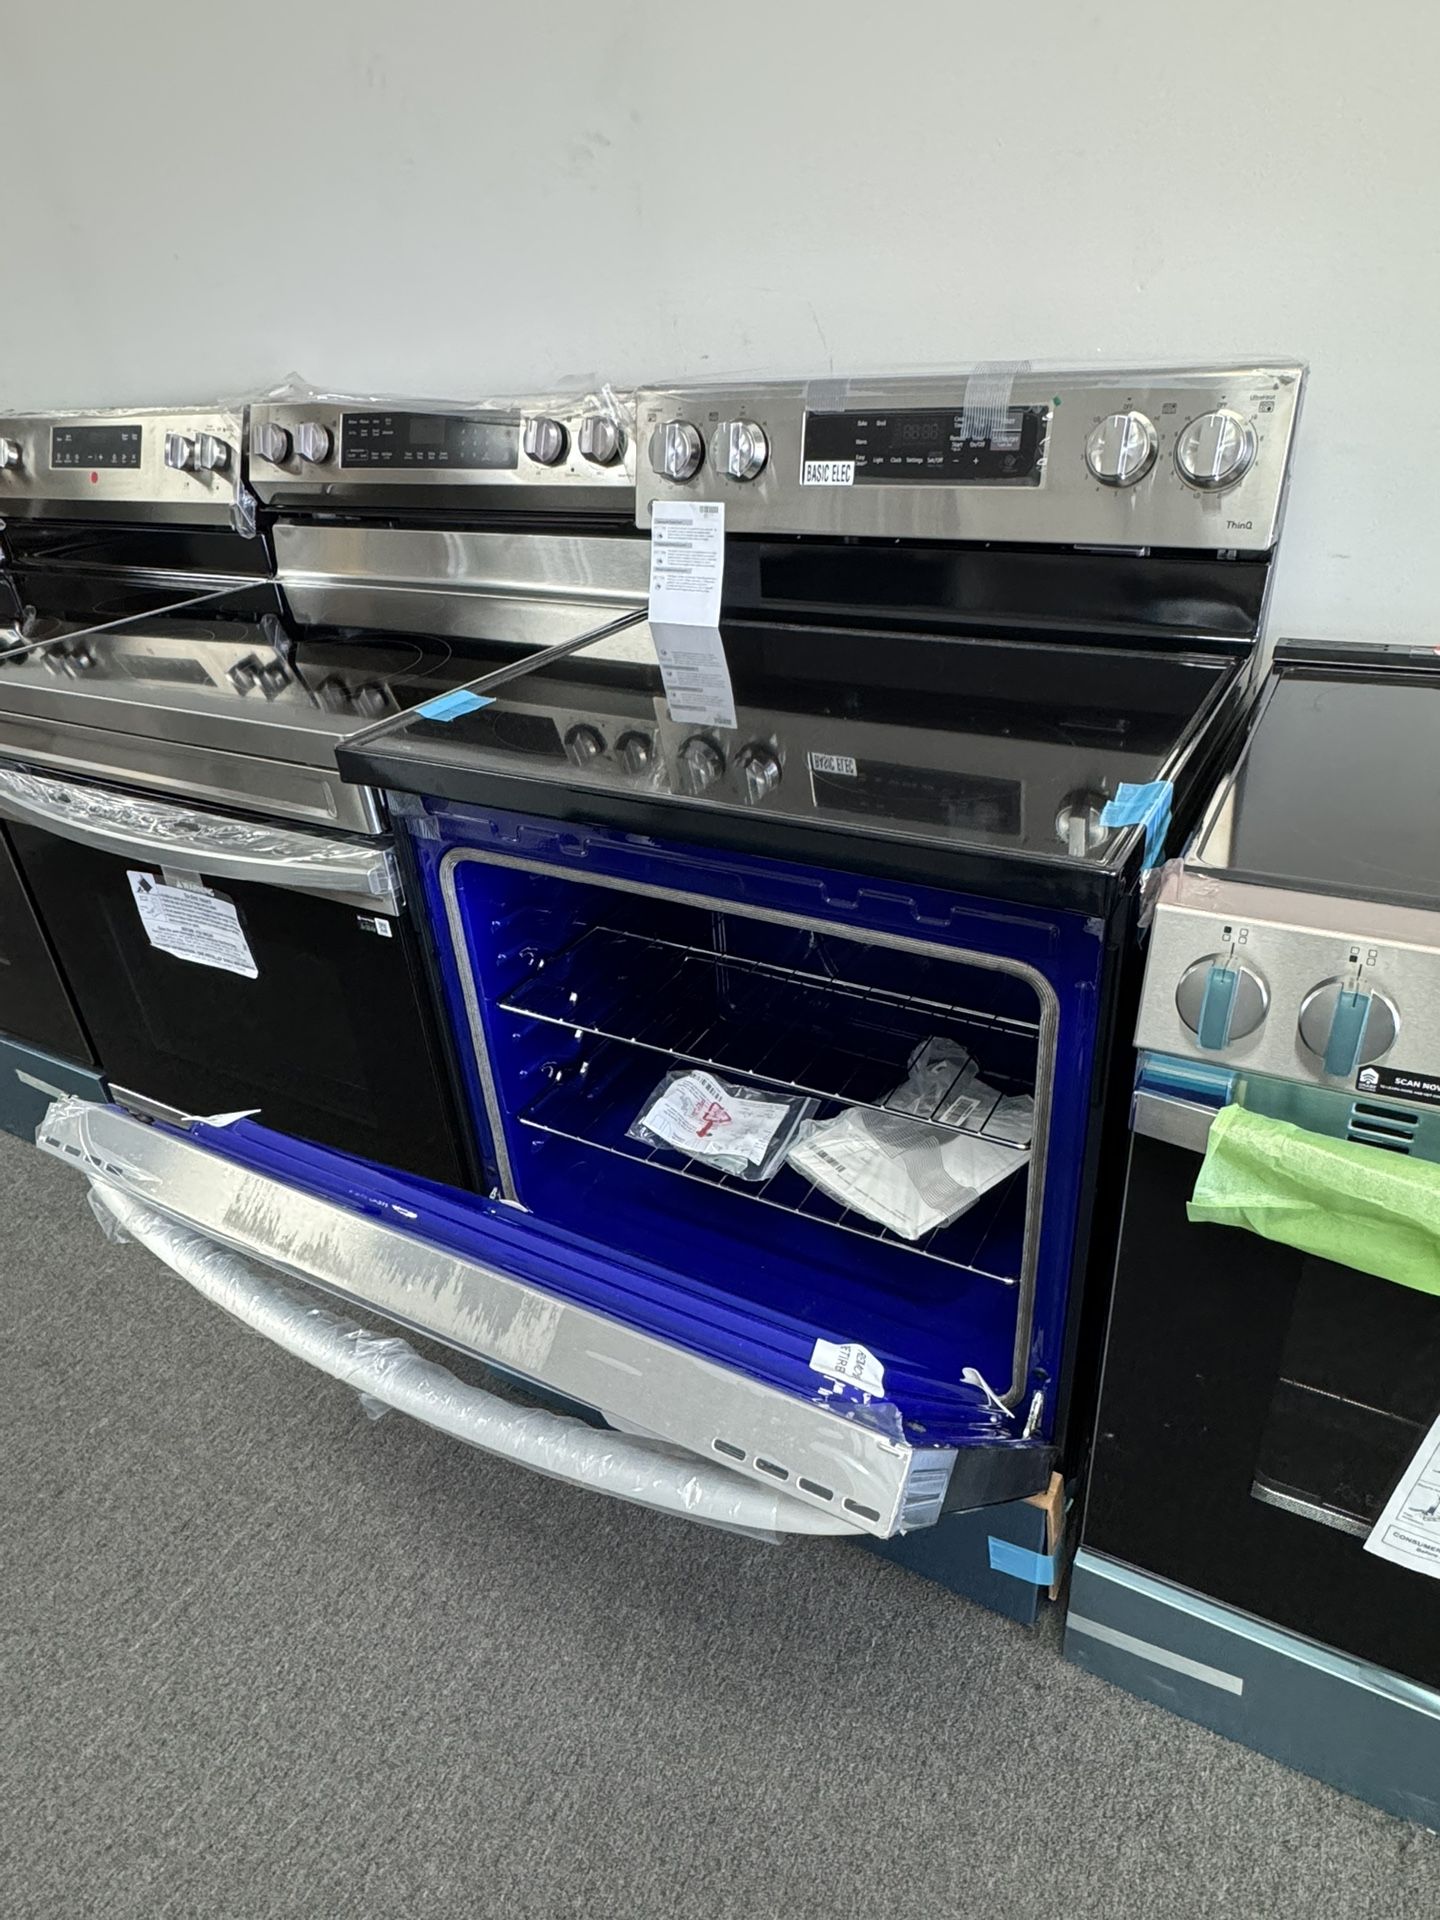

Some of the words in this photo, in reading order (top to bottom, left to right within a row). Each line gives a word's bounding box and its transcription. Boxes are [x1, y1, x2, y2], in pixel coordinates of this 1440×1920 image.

[806, 464, 830, 482] BASIC
[831, 464, 852, 482] ELEC
[1226, 520, 1253, 530] ThinQ
[1394, 1077, 1421, 1089] SCAN
